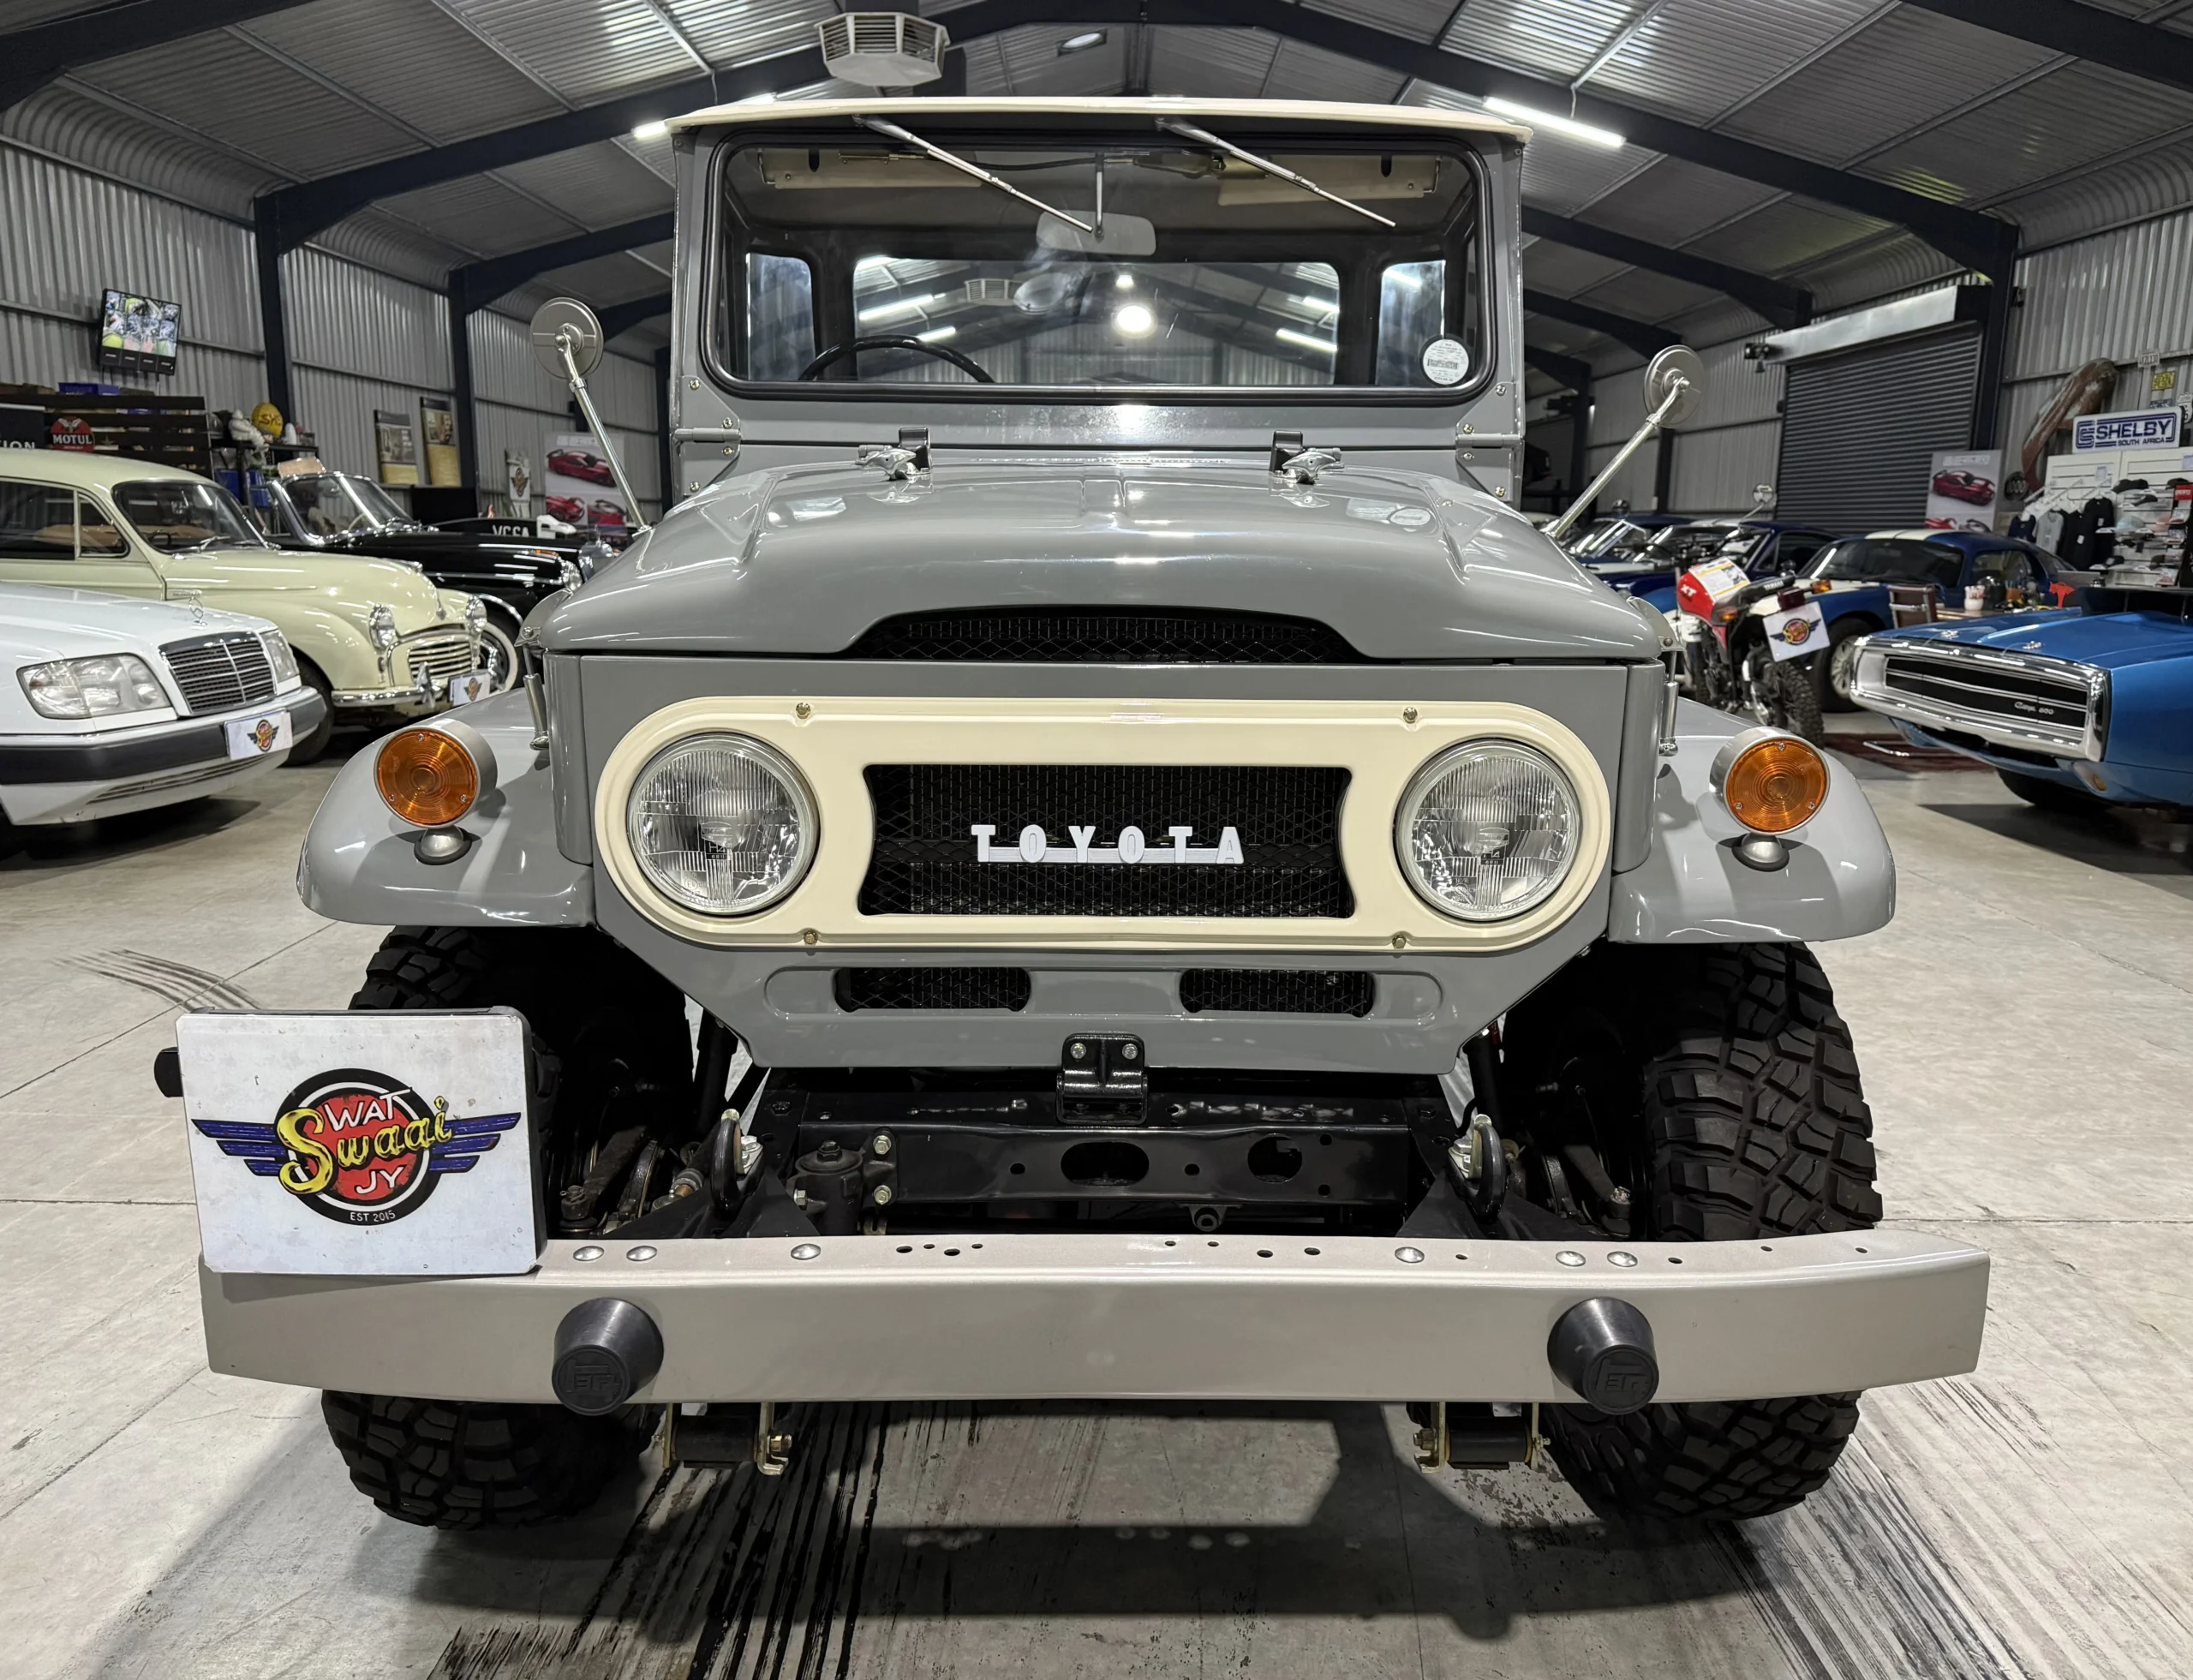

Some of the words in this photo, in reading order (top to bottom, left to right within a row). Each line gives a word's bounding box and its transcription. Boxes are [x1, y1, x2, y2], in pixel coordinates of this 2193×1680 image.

[52, 434, 93, 445] MOTUL
[2095, 419, 2172, 440] SHELBY
[0, 439, 36, 450] ION
[1681, 584, 1698, 598] XT
[971, 824, 1245, 864] TOYOTA
[323, 1087, 412, 1132] WAT
[276, 1096, 453, 1195] Swaai
[354, 1166, 405, 1195] JY
[350, 1211, 370, 1223] EST
[373, 1210, 396, 1223] 2015
